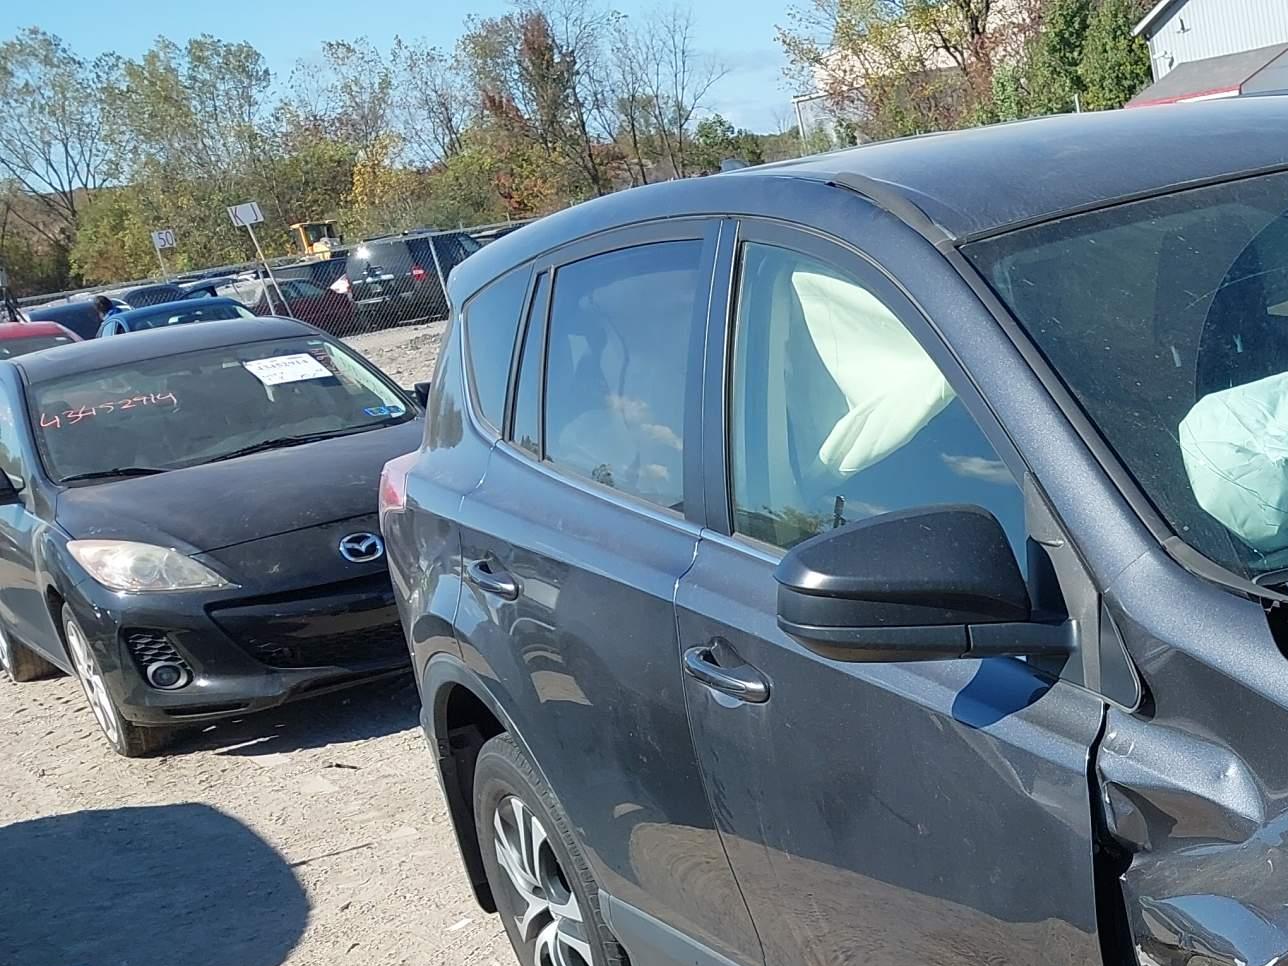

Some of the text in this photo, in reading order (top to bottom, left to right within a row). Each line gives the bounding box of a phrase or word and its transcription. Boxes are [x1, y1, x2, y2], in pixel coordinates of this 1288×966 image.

[231, 203, 259, 226] K J
[157, 231, 175, 247] 50
